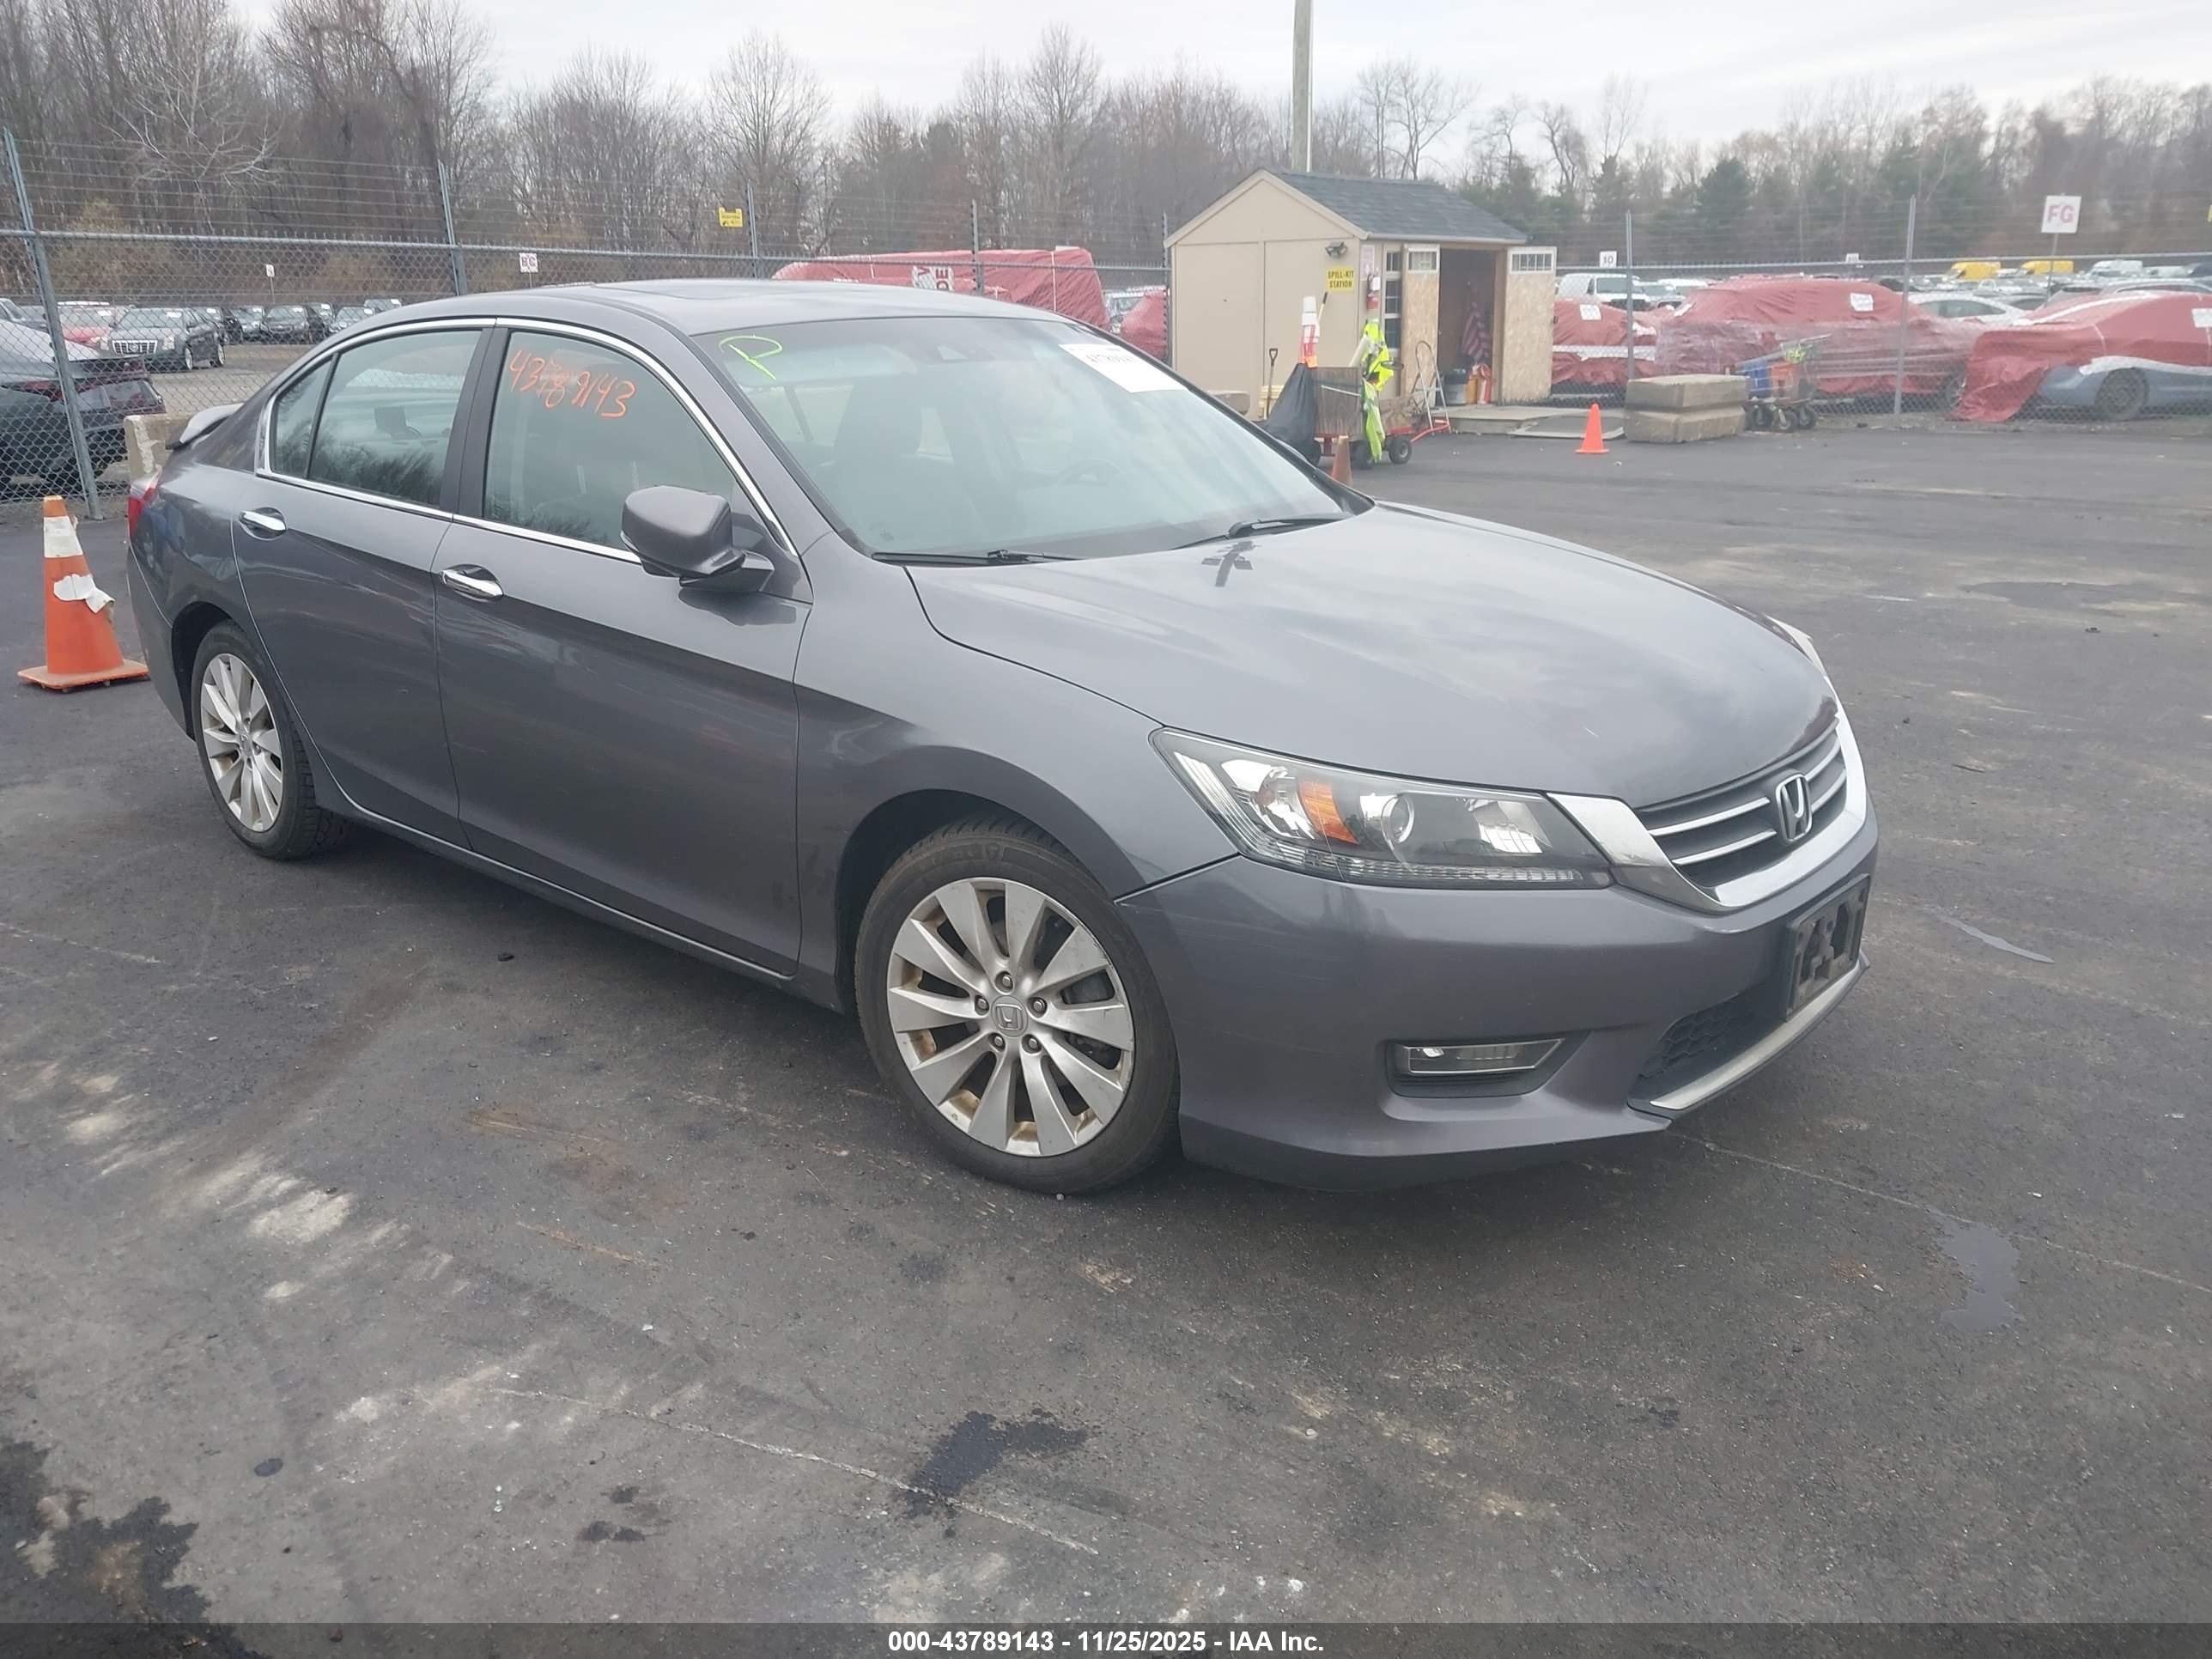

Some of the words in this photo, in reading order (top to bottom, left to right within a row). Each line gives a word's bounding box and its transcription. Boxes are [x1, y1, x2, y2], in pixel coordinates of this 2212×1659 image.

[2047, 204, 2075, 223] FG
[1603, 255, 1614, 264] 10
[1328, 270, 1354, 279] SPILL-KIT
[1329, 280, 1352, 289] STATION
